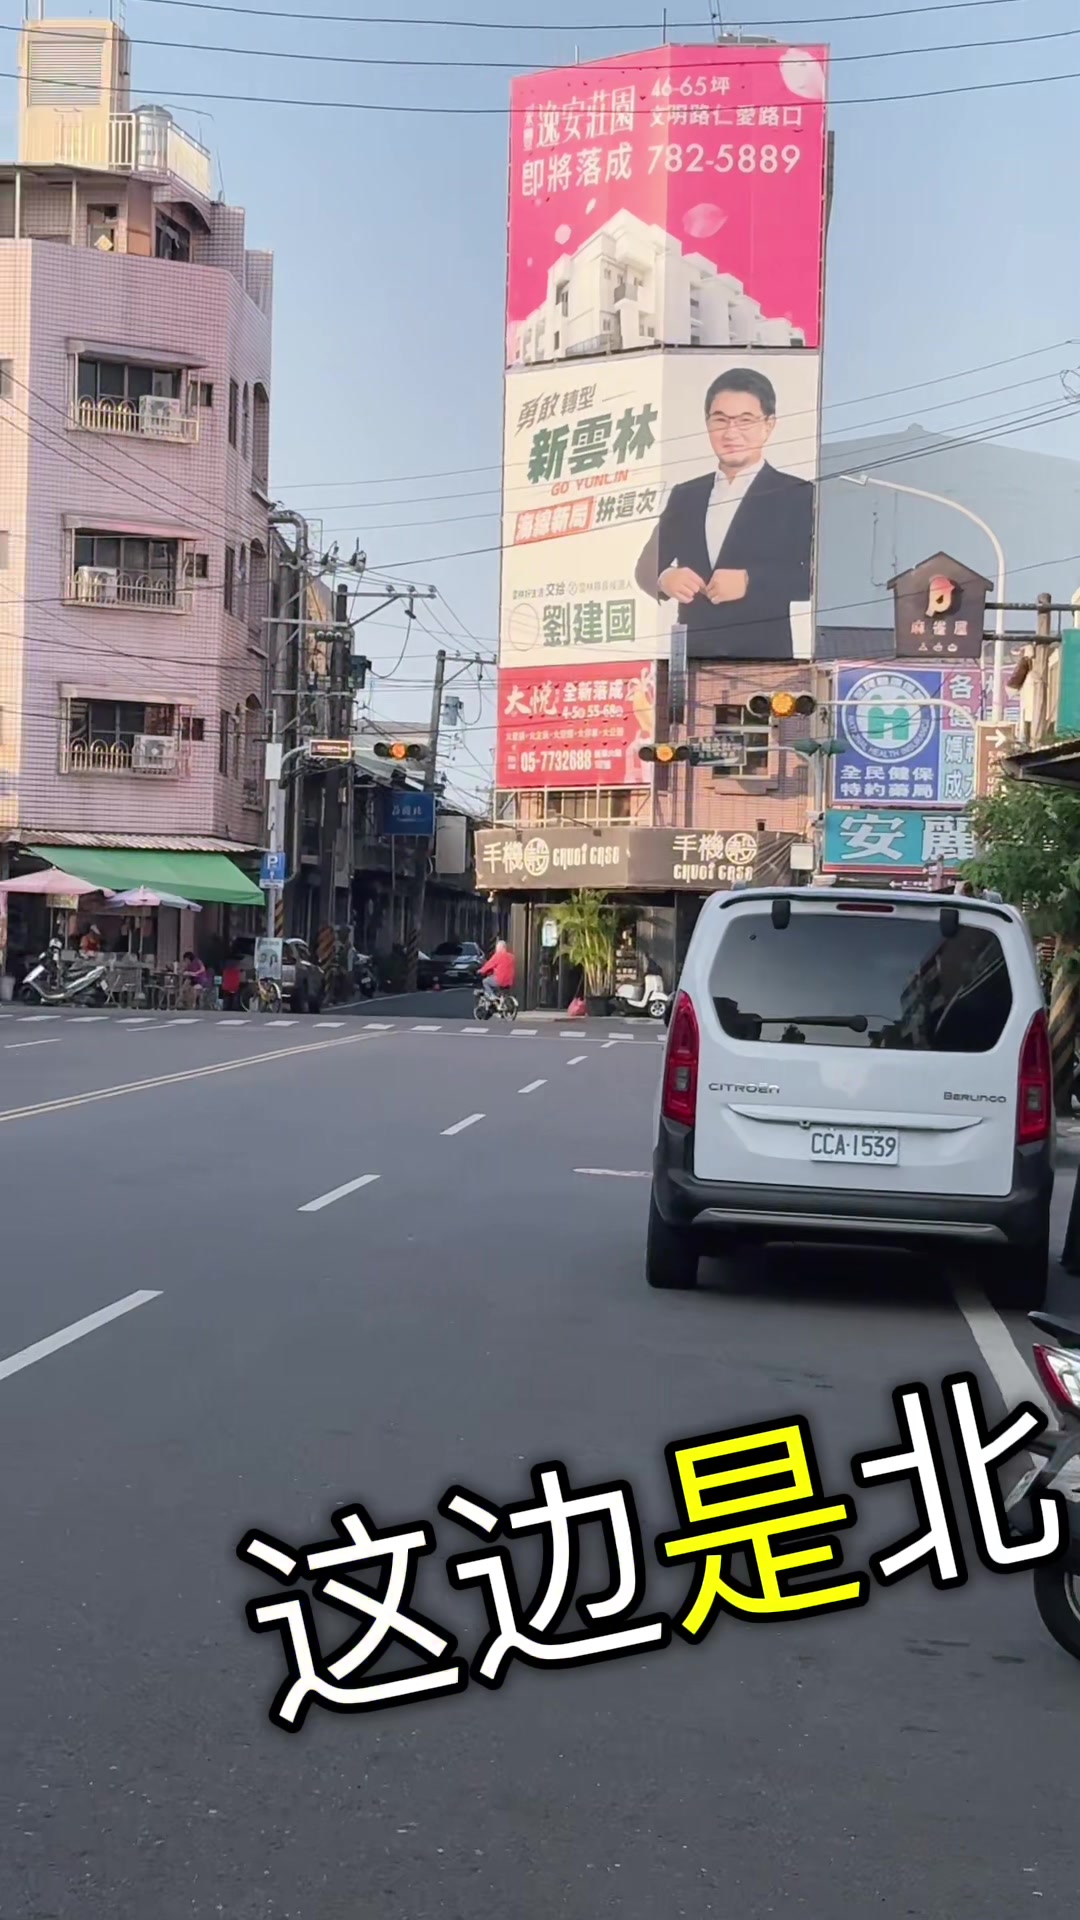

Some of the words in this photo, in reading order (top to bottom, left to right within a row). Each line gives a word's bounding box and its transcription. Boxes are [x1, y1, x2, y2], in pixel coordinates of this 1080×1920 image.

[651, 76, 731, 98] 46-65坪
[649, 104, 803, 128] 文明路仁愛路口
[521, 141, 633, 197] 即將落成
[647, 144, 802, 175] 782-5889
[514, 383, 598, 437] 勇敢轉型
[527, 403, 659, 484] 新雲林
[551, 481, 569, 497] GO
[575, 469, 630, 491] YUNLIN
[542, 598, 636, 648] 劉建國
[910, 619, 969, 637] 麻雀屋
[562, 679, 625, 703] 全新落成
[868, 746, 901, 759] HEALTH
[840, 764, 935, 781] 全民健保
[840, 781, 935, 798] 特約藥局
